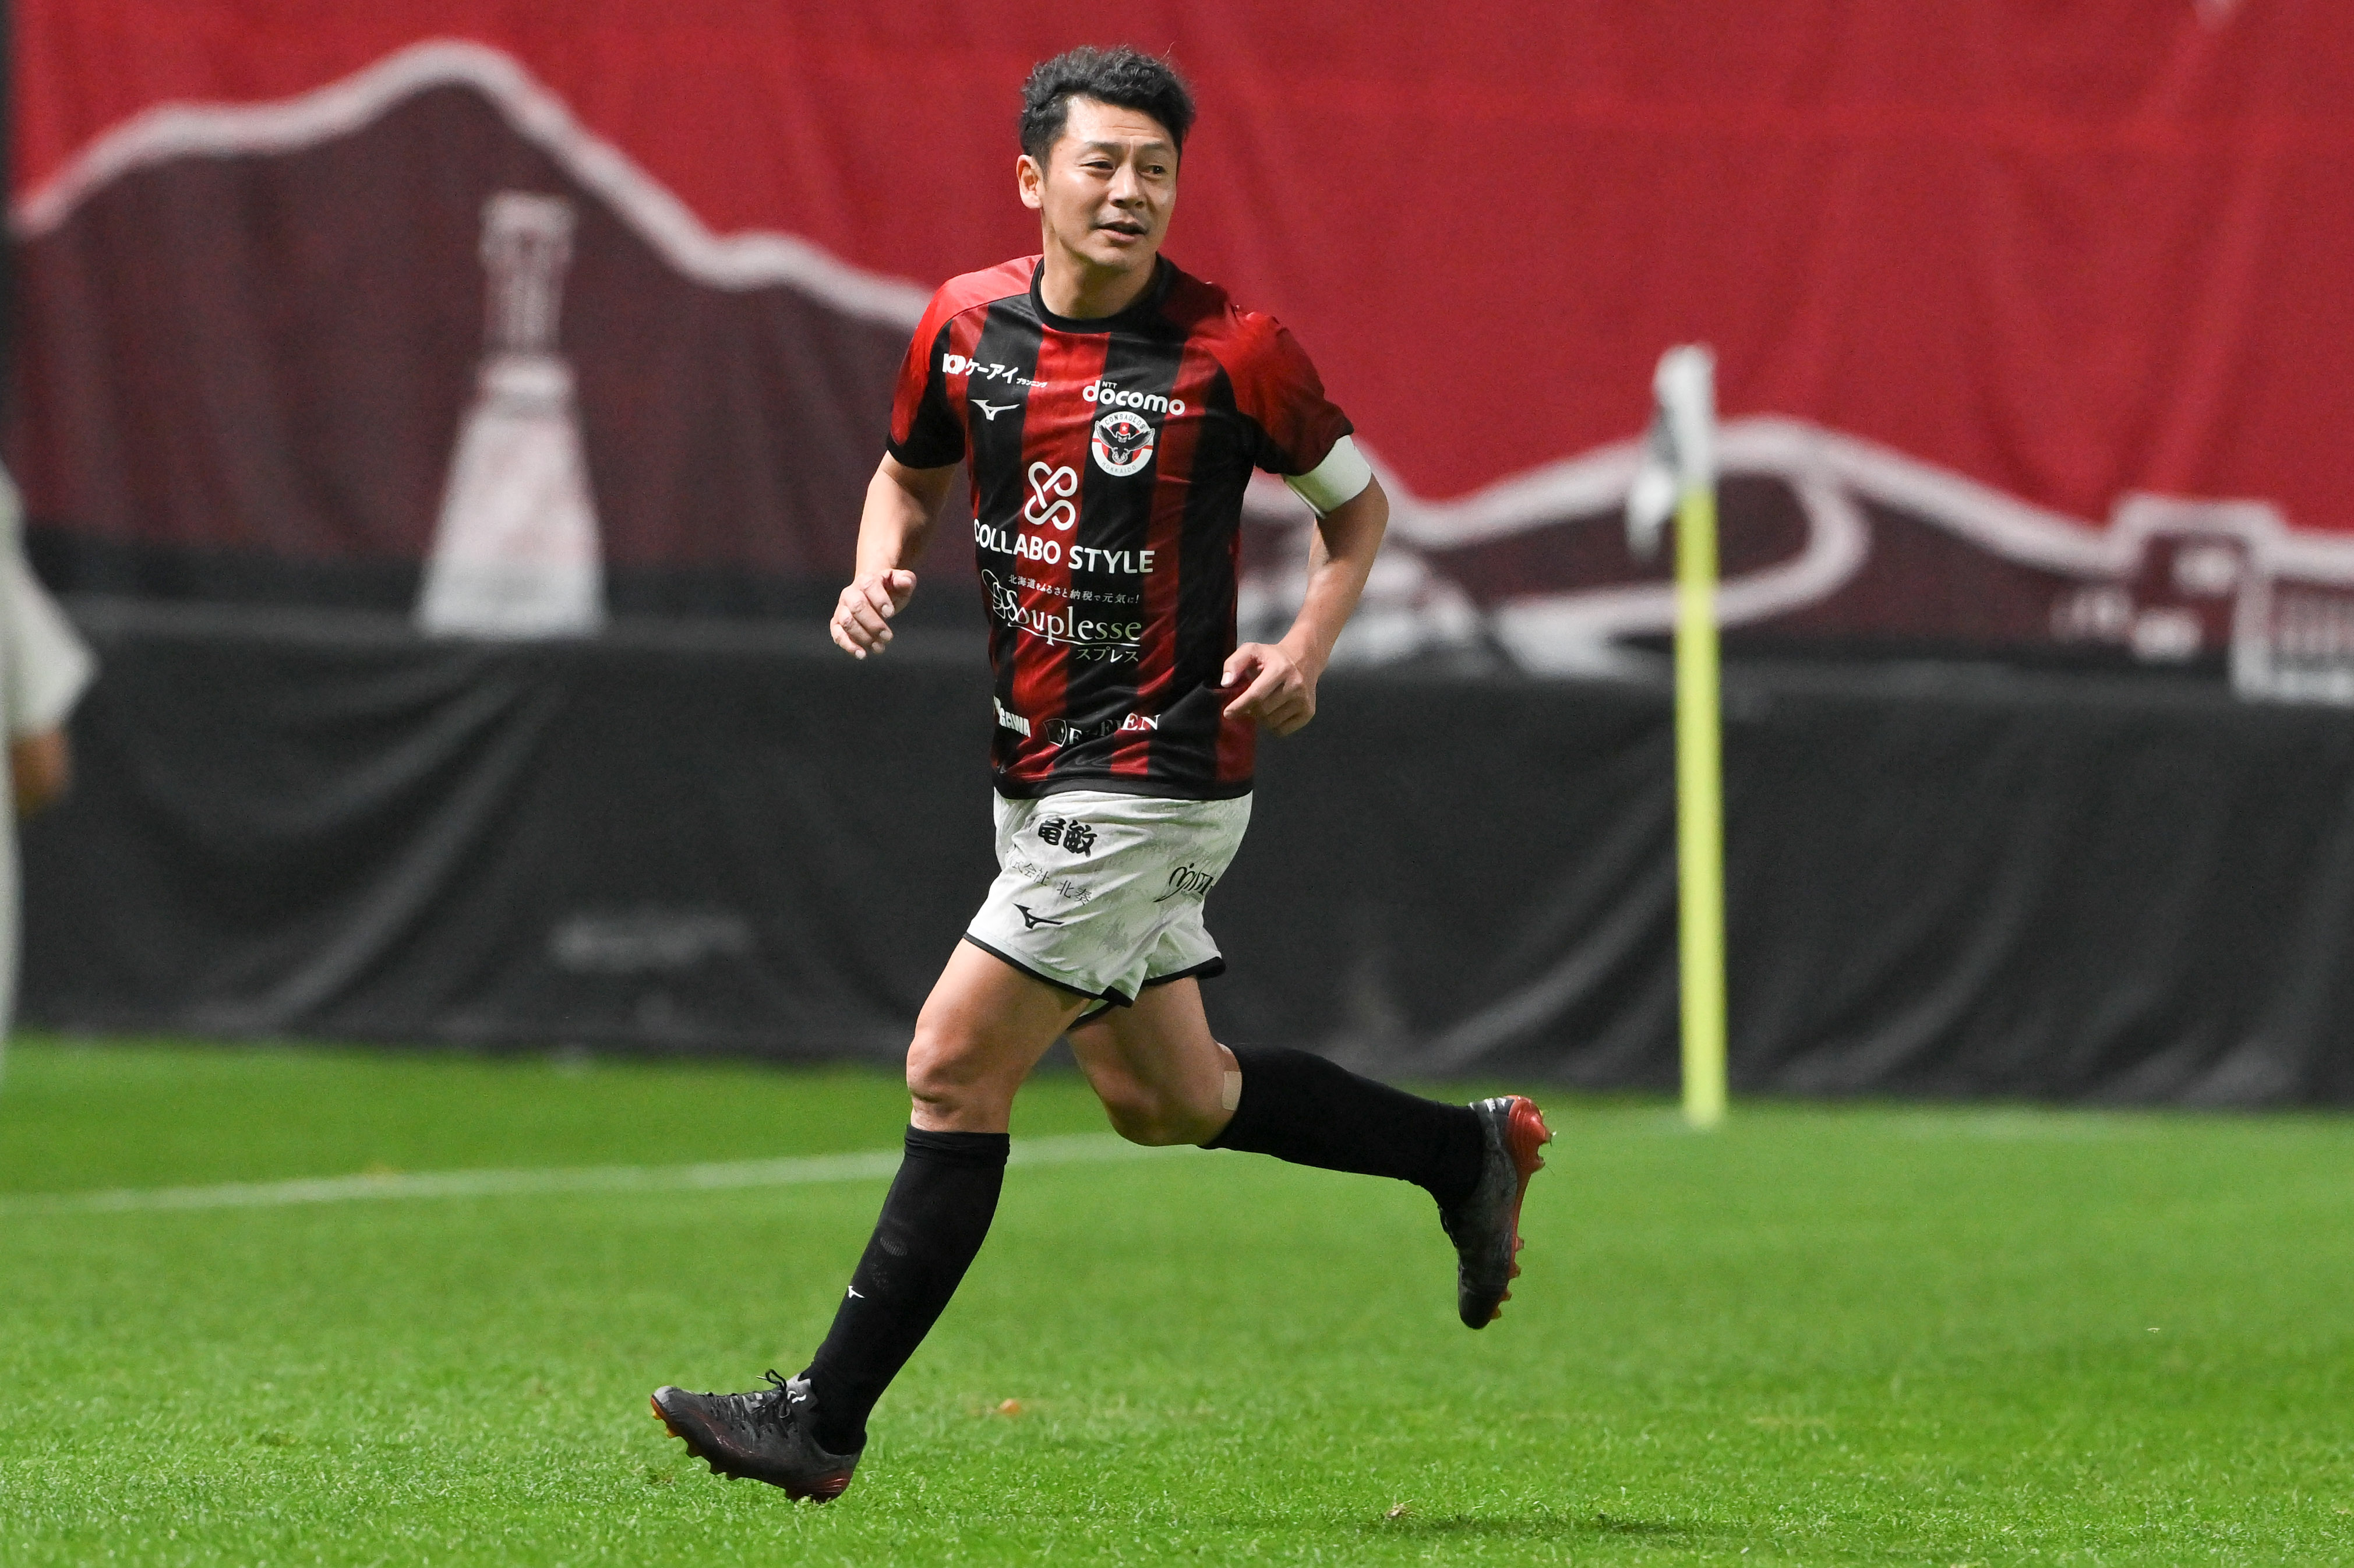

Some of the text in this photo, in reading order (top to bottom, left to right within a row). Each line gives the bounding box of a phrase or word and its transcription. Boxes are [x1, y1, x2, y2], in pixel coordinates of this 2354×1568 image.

[1102, 381, 1117, 389] NTT
[1083, 380, 1185, 415] docomo
[1102, 462, 1137, 474] HOKKAIDO
[974, 518, 1155, 574] COLLABO STYLE
[1076, 646, 1139, 663] スプレス
